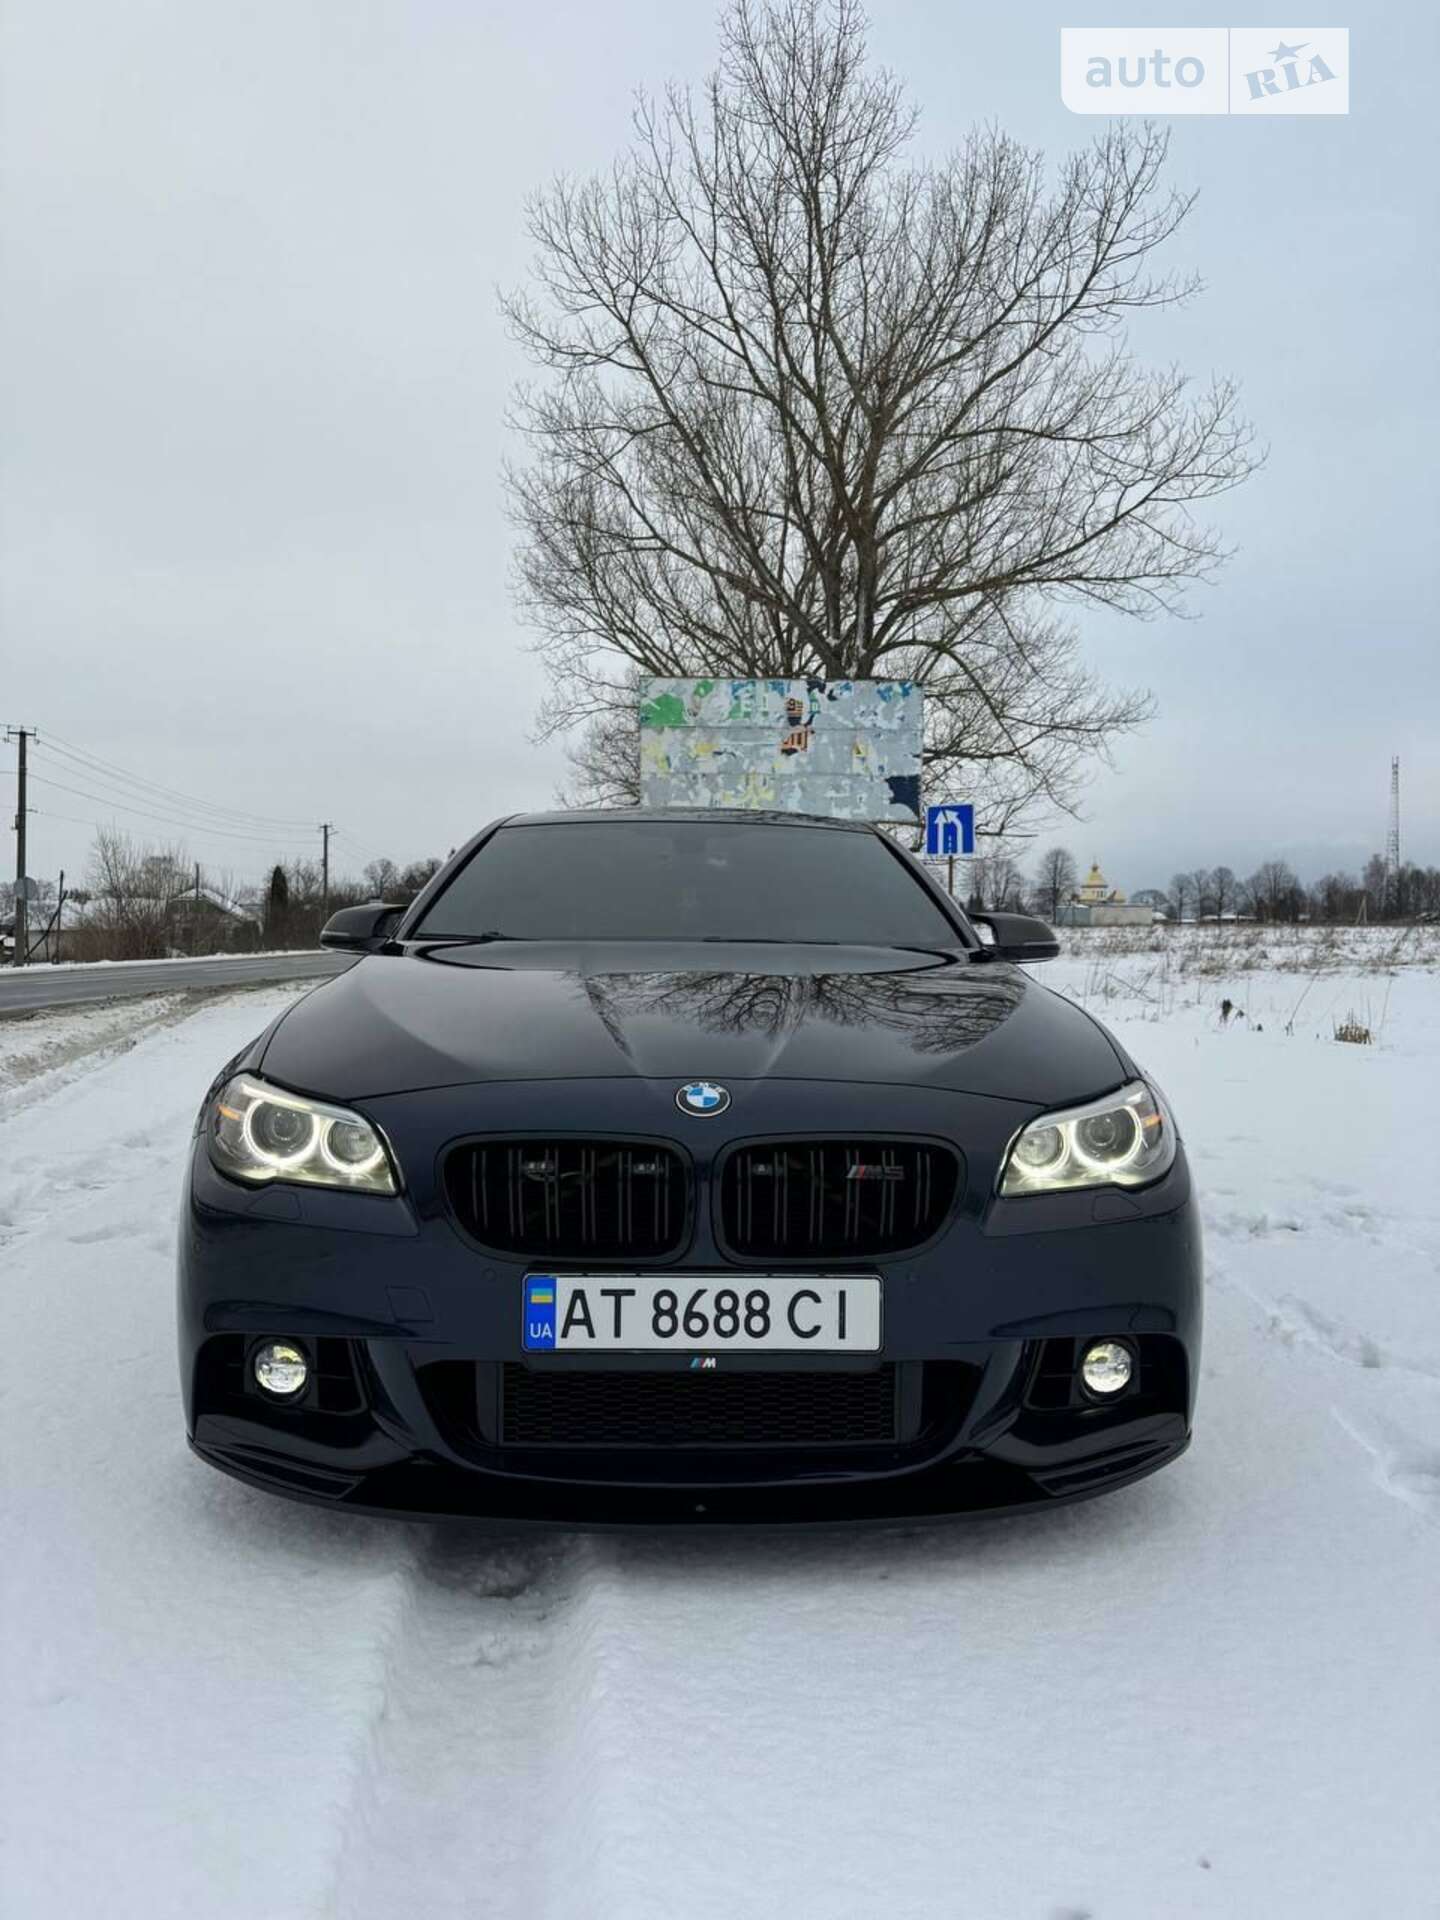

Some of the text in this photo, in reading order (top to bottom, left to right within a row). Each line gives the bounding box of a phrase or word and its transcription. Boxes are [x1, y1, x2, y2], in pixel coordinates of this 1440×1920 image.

[530, 1322, 553, 1339] UA
[560, 1289, 847, 1340] AT 8688 CI
